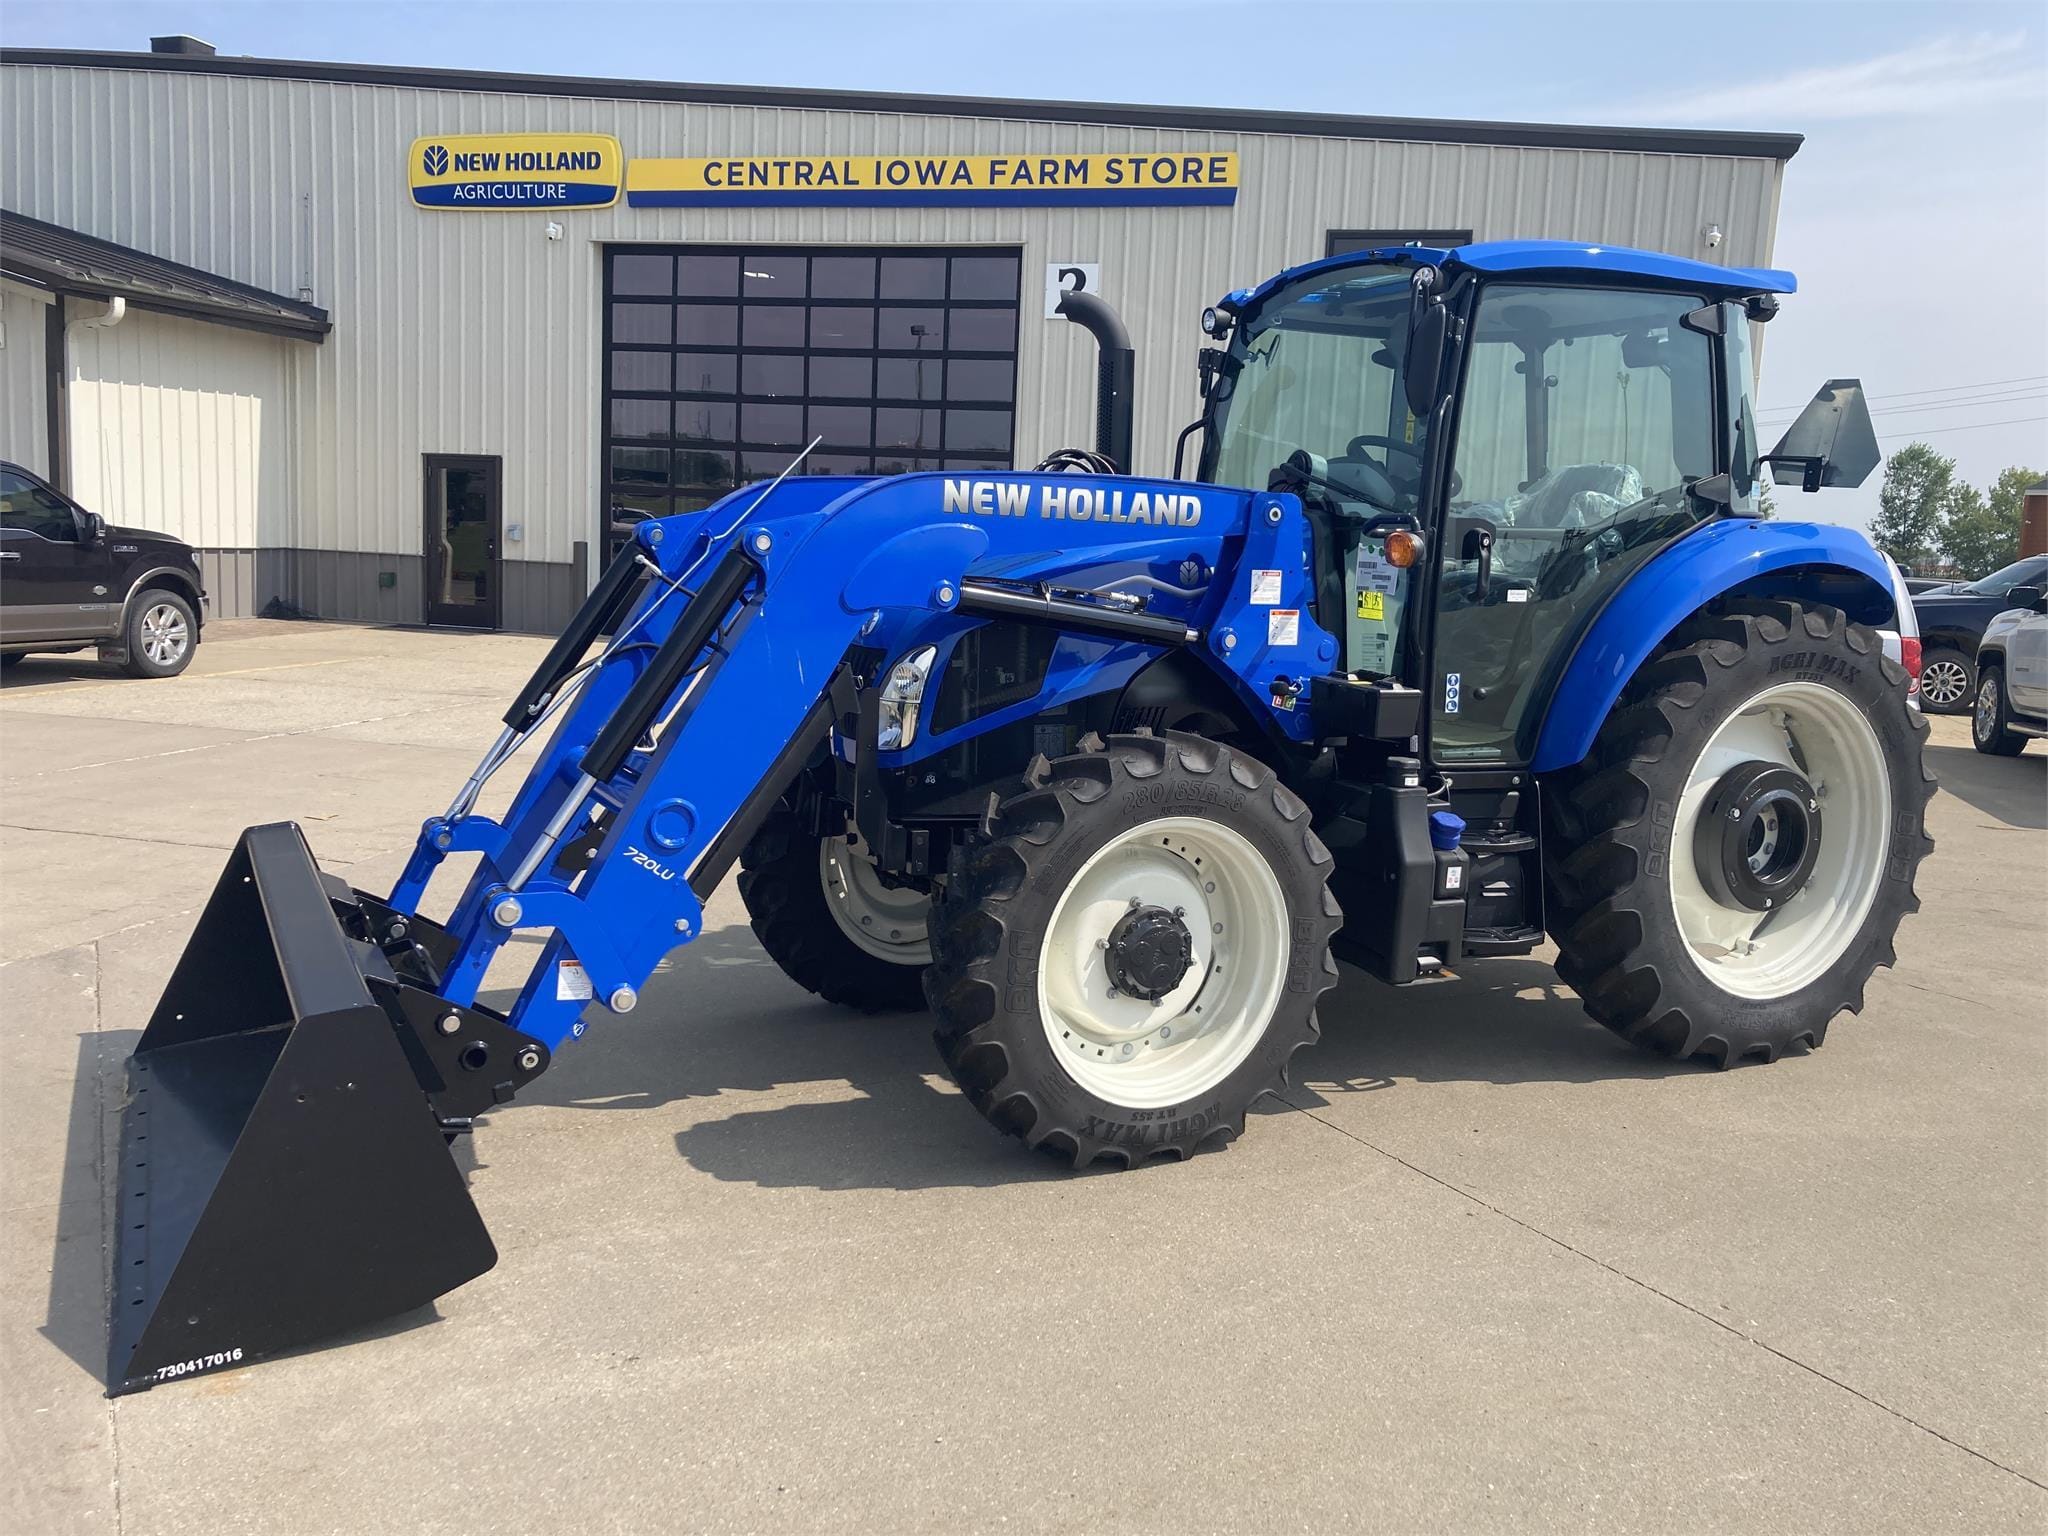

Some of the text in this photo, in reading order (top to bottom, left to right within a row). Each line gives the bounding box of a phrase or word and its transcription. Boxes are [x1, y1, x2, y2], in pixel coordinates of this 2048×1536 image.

[454, 151, 601, 172] NEW HOLLAND
[703, 156, 1229, 187] CENTRAL IOWA FARM STORE
[453, 184, 567, 200] AGRICULTURE
[1054, 267, 1087, 314] 2
[943, 479, 1202, 528] NEW HOLLAND
[1817, 653, 1861, 683] MAX
[623, 846, 676, 880] 720LU
[157, 1347, 243, 1380] 730417016
